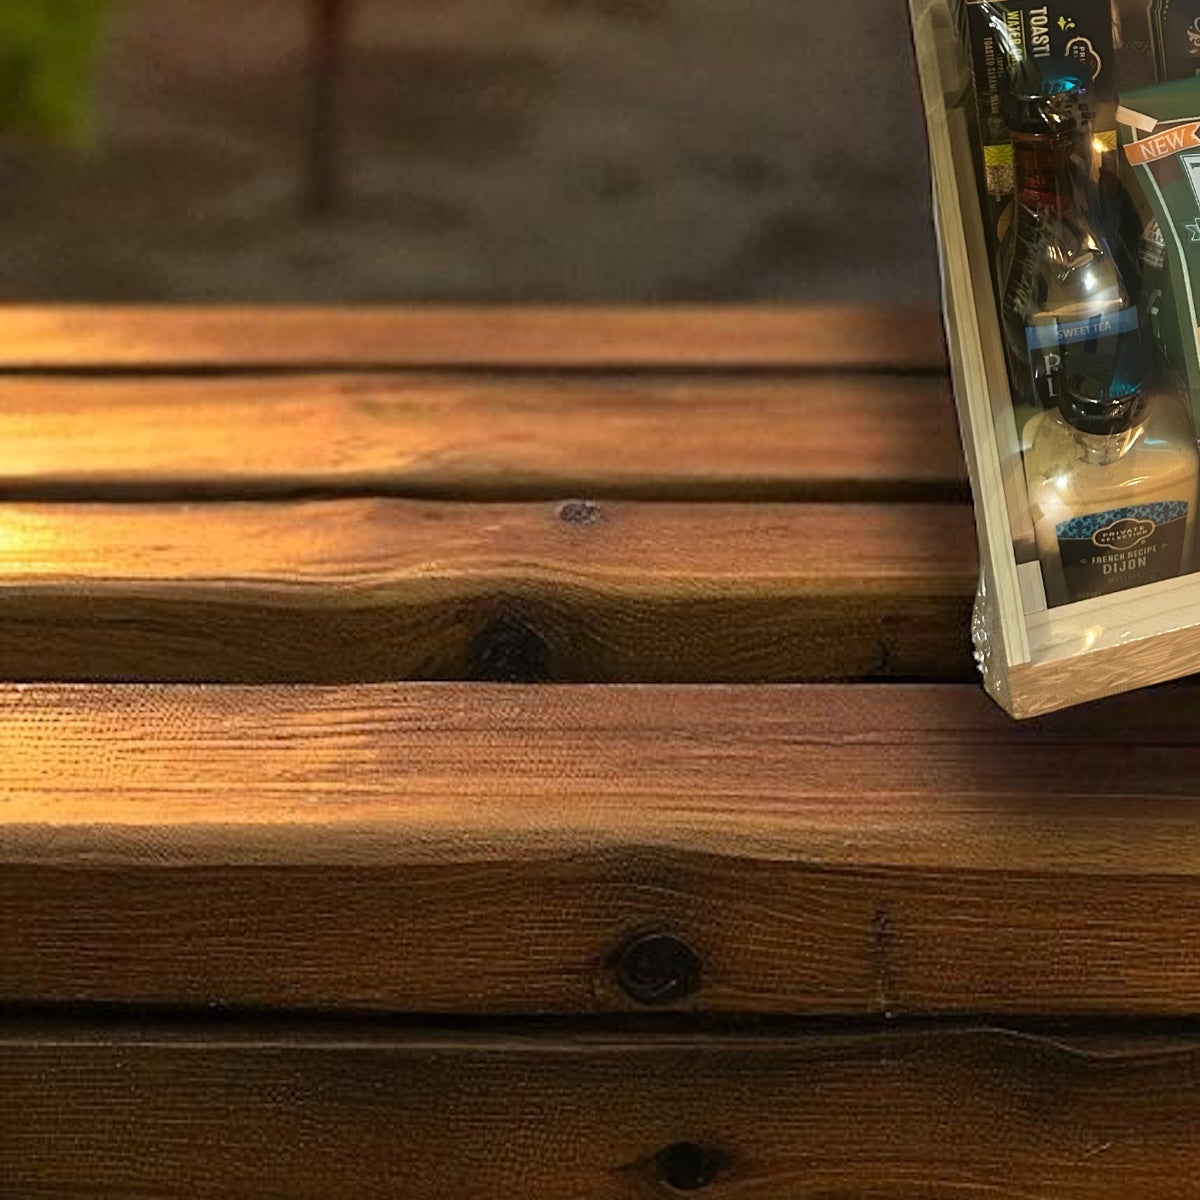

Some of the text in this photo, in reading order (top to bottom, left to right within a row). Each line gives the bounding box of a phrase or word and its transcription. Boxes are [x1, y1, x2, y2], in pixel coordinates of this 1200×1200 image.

[1028, 6, 1051, 58] TOAST
[1140, 129, 1187, 161] NEW
[1056, 321, 1112, 340] SWEET TEA
[1101, 530, 1148, 543] SELECTION
[1102, 525, 1145, 538] PRIVATE
[1091, 544, 1158, 565] FRENCH RECIPE
[1102, 556, 1147, 575] DIJON
